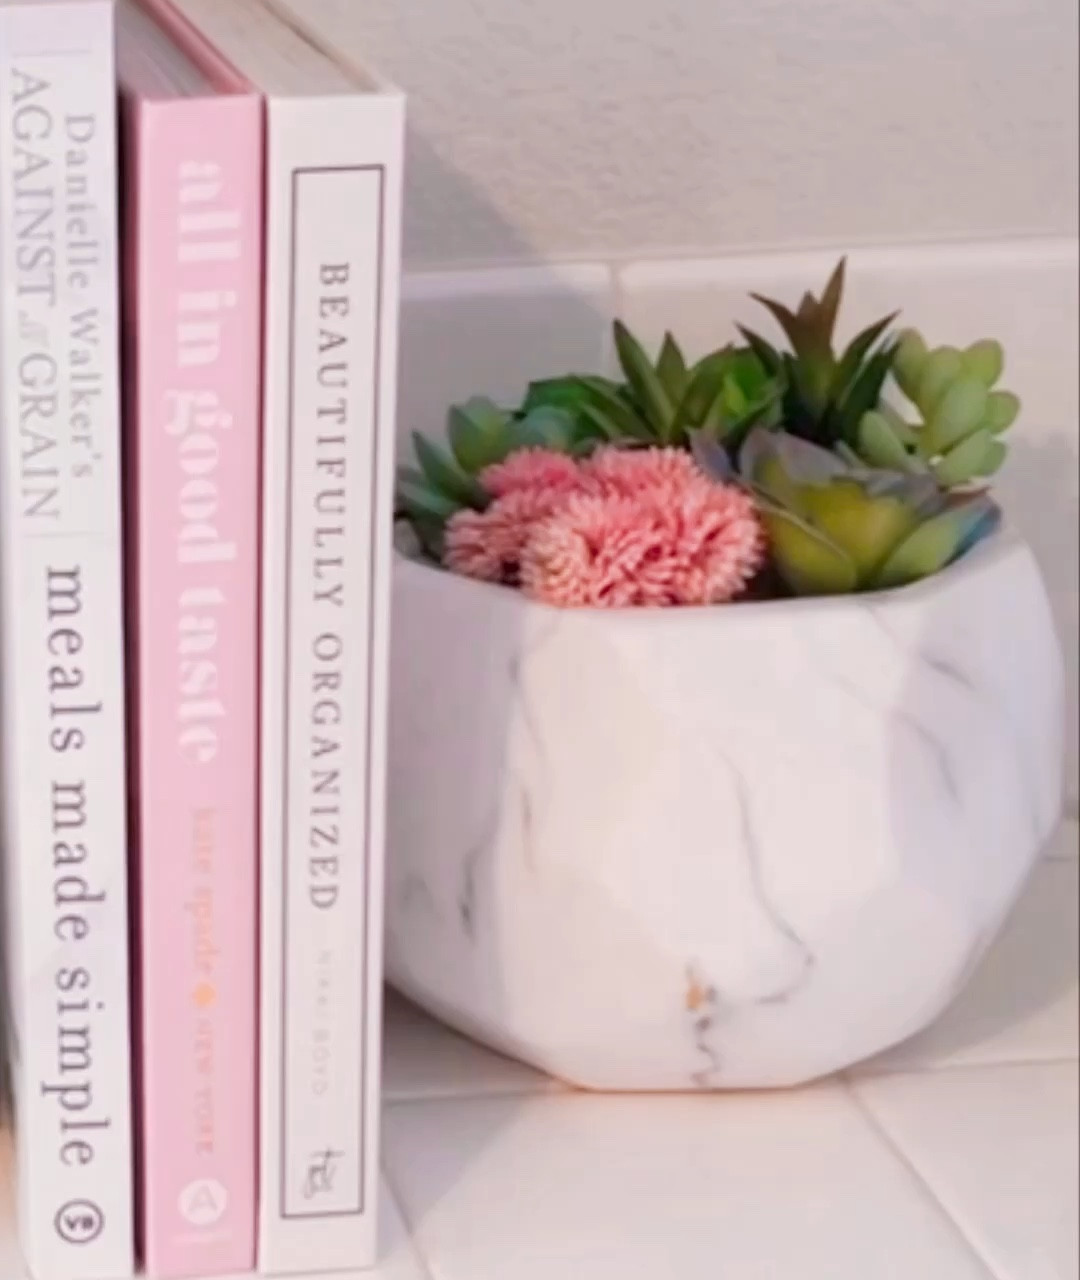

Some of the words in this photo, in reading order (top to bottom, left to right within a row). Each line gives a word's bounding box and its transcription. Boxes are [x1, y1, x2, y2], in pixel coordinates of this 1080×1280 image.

[11, 67, 57, 308] AGAINST
[65, 113, 98, 290] Danielle
[177, 160, 241, 262] all
[69, 307, 103, 478] Walker's
[177, 290, 238, 368] in
[18, 352, 61, 520] GRAIN
[164, 389, 238, 563] good
[312, 262, 350, 607] BEAUTIFULLY
[45, 564, 102, 753] meals
[178, 586, 227, 765] taste
[308, 631, 343, 910] ORGANIZED
[51, 779, 107, 942] made
[41, 966, 111, 1166] simple
